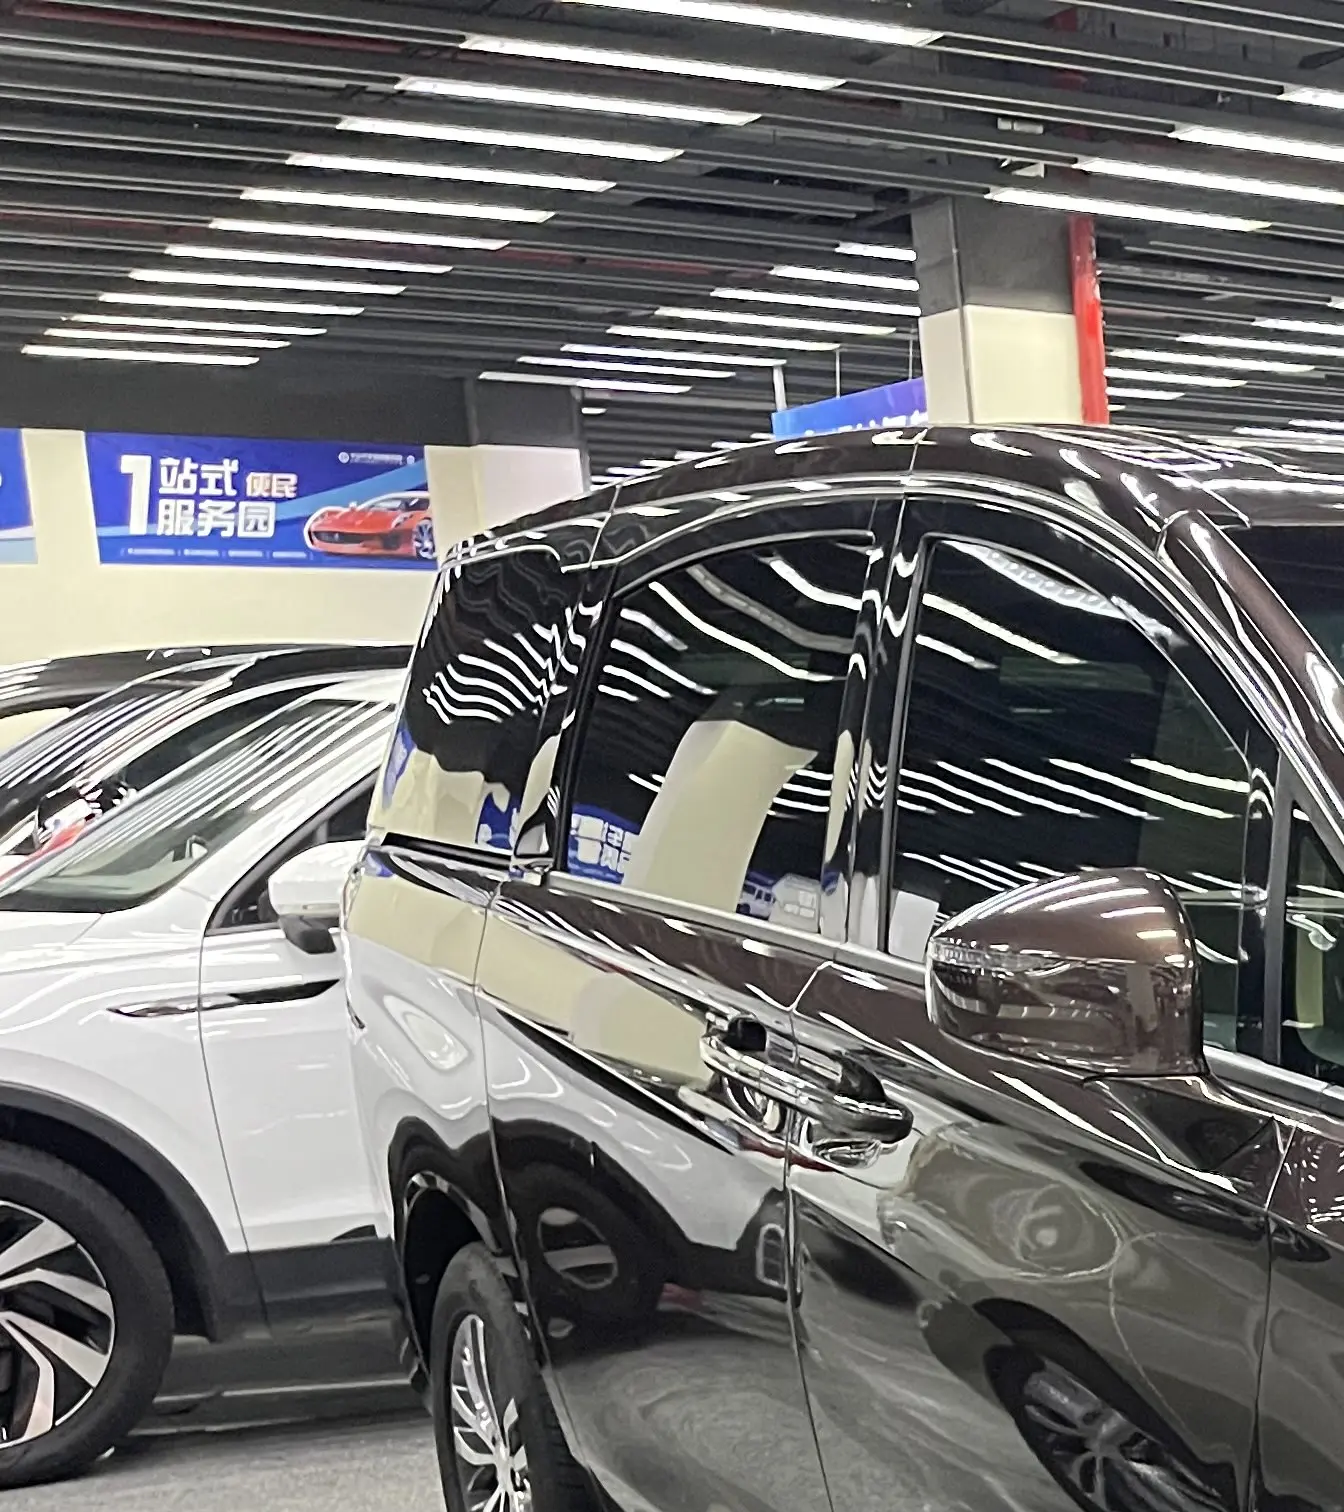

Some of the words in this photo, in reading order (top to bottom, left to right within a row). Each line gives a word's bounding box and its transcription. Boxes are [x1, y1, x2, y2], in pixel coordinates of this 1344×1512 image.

[245, 471, 298, 499] 便民
[156, 498, 276, 538] 服务园
